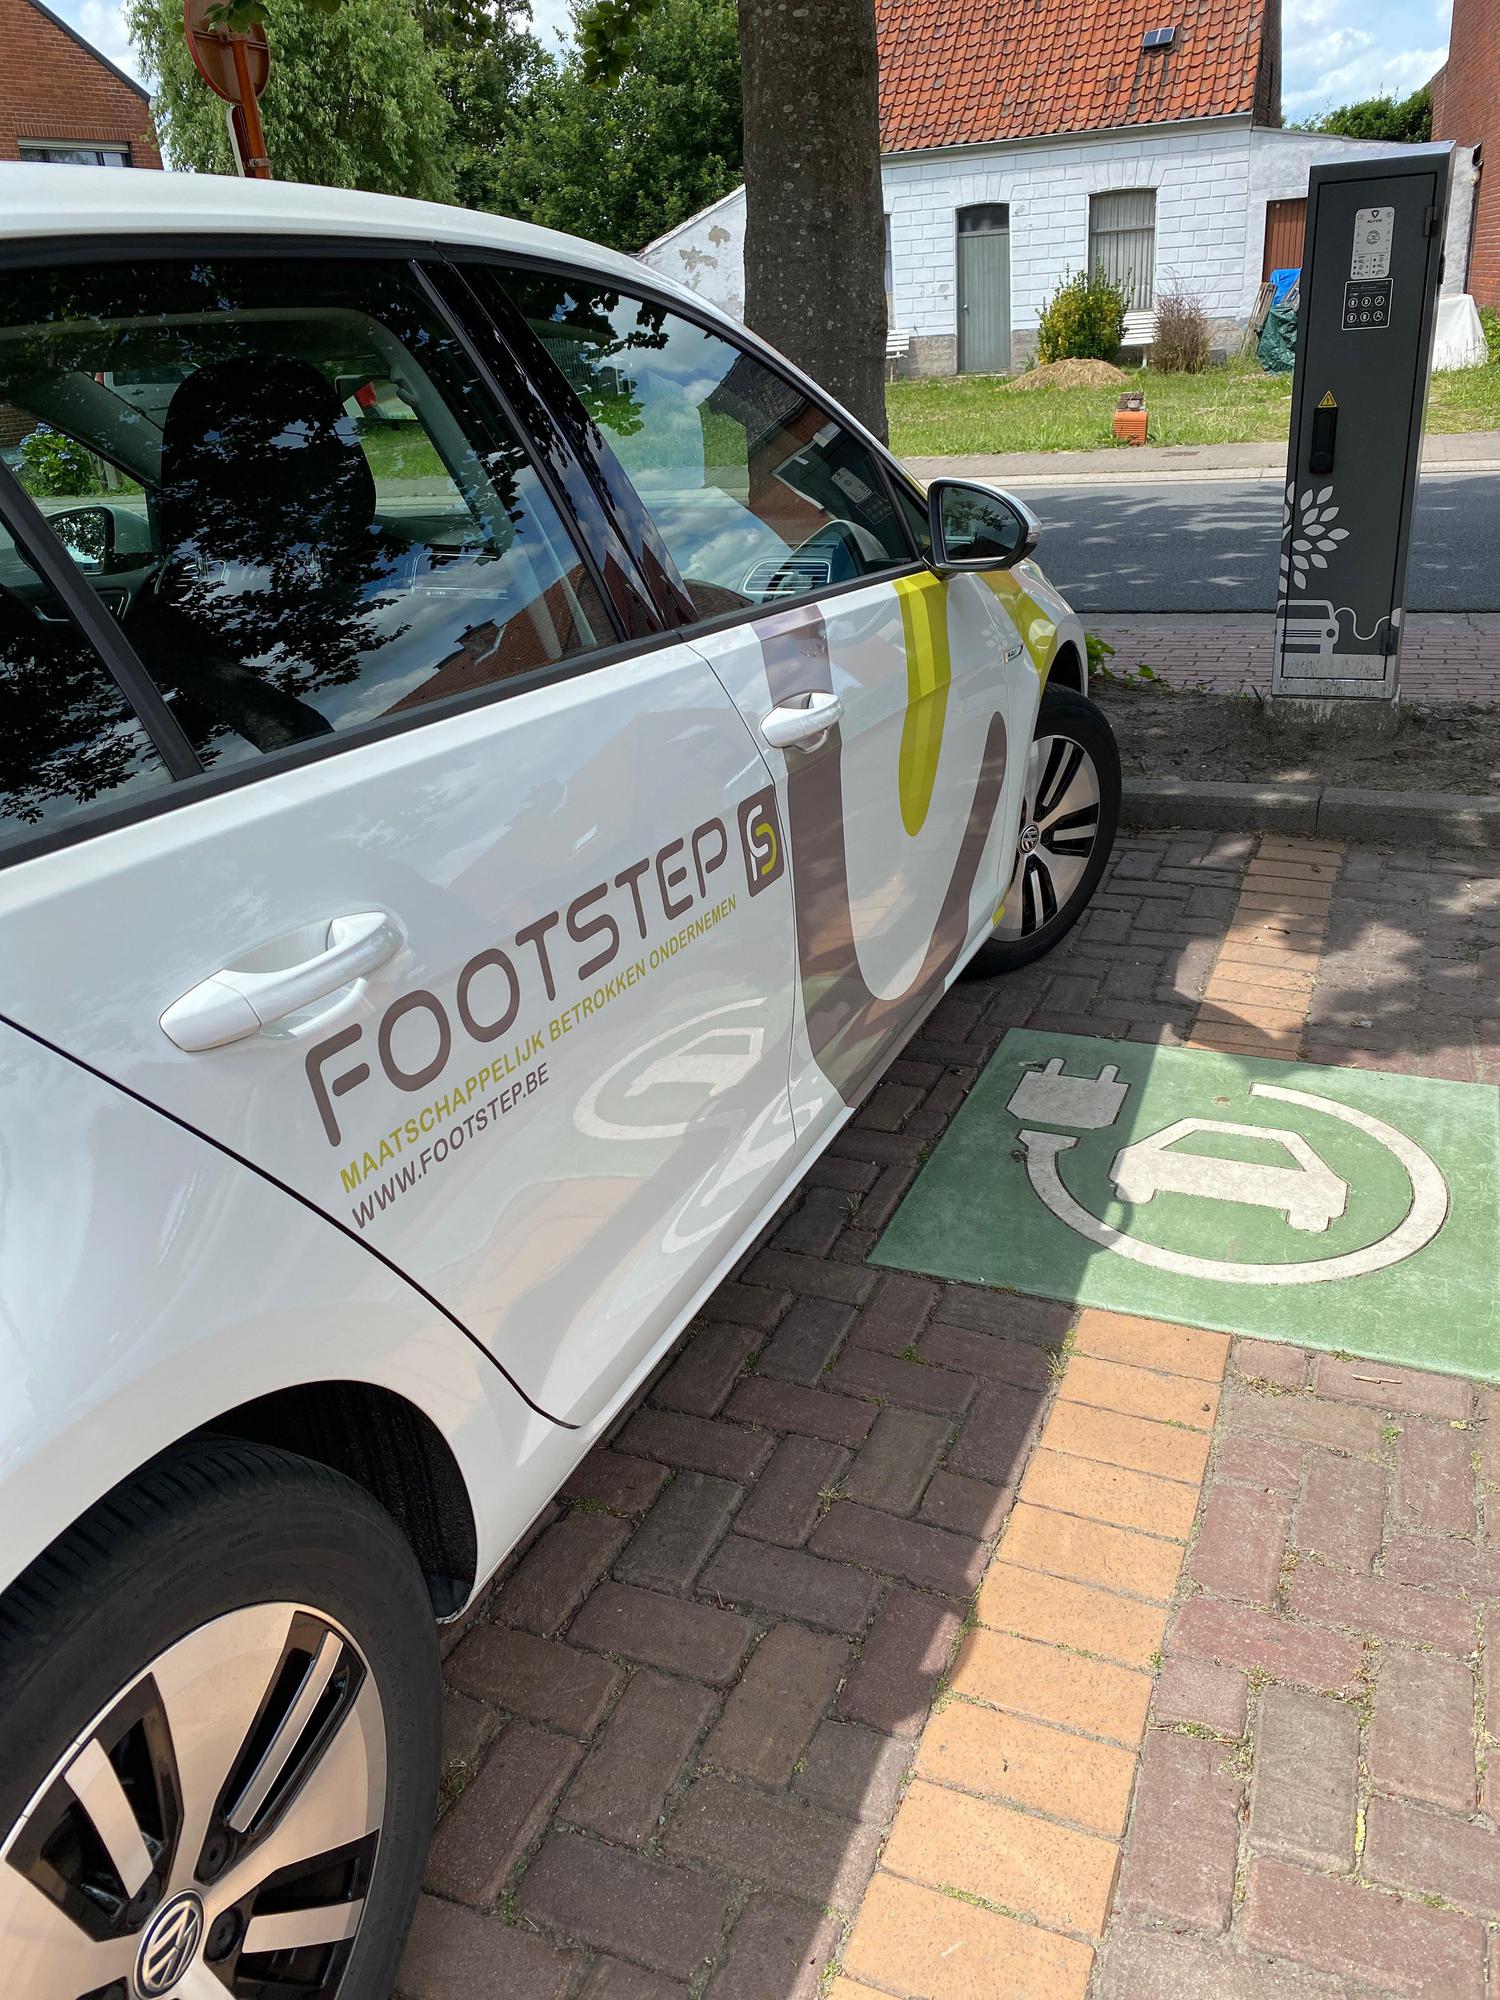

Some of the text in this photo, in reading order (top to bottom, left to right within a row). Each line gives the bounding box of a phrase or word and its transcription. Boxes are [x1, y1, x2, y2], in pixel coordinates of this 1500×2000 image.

[305, 816, 728, 1148] FOOTSTEP
[339, 893, 737, 1195] MAATSCHAPPELIJK BETROKKEN ONDERNEMEN
[351, 1062, 550, 1229] WWW.FOOTSTEP.BE
